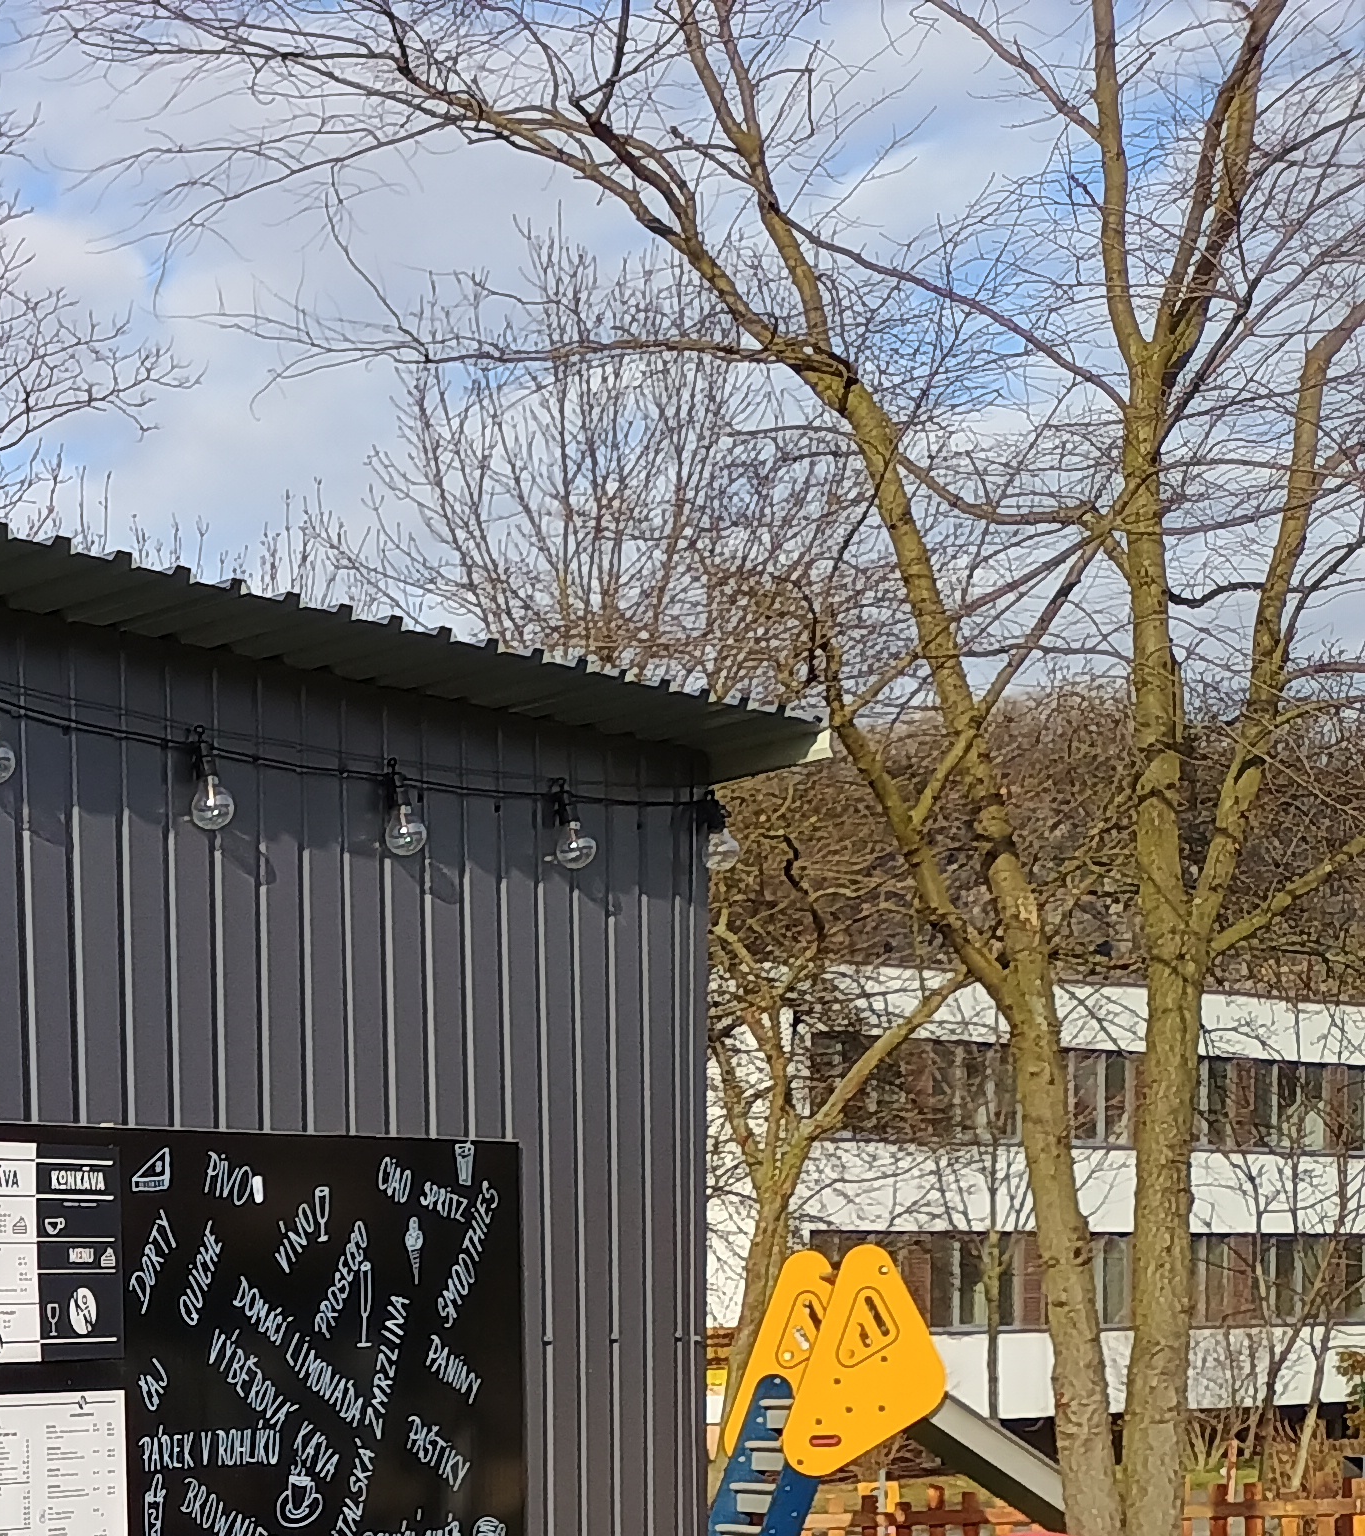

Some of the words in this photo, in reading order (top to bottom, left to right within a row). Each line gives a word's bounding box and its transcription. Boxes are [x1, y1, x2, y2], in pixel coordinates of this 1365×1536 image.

[204, 1151, 253, 1206] PIVO
[378, 1156, 412, 1203] CIAO
[420, 1181, 469, 1223] SPRITZ
[68, 1247, 95, 1264] MENU
[129, 1208, 177, 1315] DORTY
[179, 1219, 223, 1326] QUICHE
[274, 1203, 315, 1274] VÍNO
[314, 1220, 368, 1339] PROSECCO
[437, 1180, 499, 1328] SMOOTHIES
[232, 1275, 295, 1346] DOMÁCÍ
[208, 1328, 300, 1431] VÝBĚROVÁ
[294, 1420, 340, 1482] KÁVA
[365, 1294, 410, 1440] ZMRZLINA
[138, 1424, 195, 1472] PÁREK
[201, 1431, 212, 1466] V
[215, 1419, 281, 1466] ROHLÍKU
